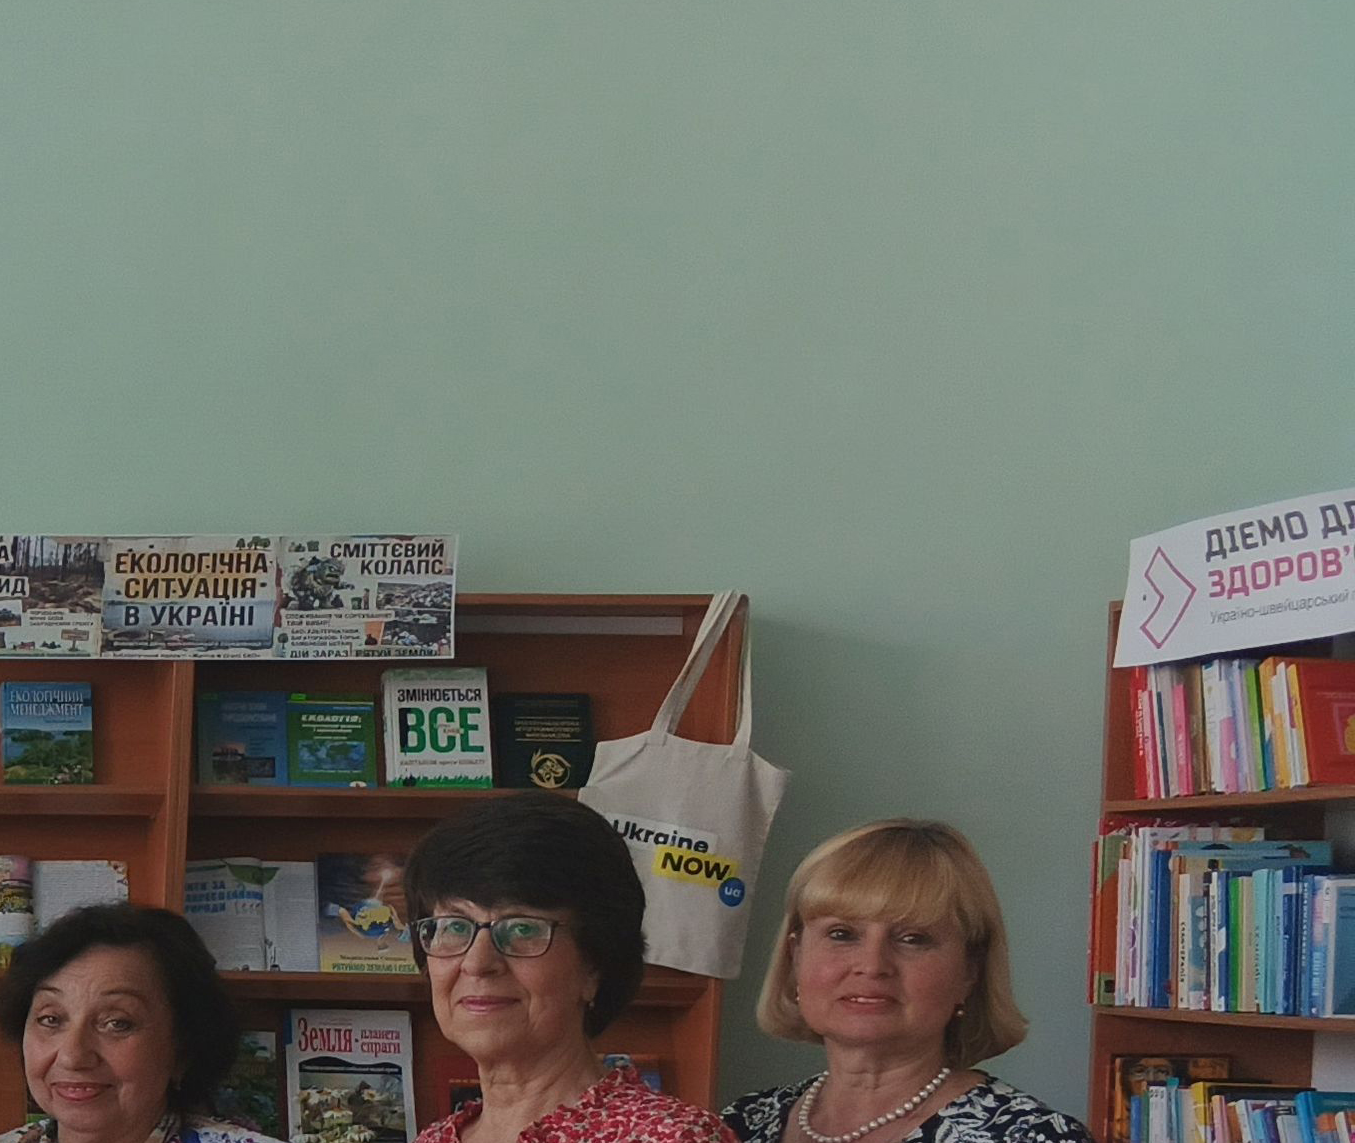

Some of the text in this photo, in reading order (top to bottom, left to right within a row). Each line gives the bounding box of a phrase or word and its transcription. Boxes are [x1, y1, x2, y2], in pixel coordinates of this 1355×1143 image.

[330, 540, 445, 559] СМІТТЄВИЙ
[115, 552, 268, 574] ЕКОЛОГІЧНА
[360, 559, 444, 576] КОЛАПС
[1208, 545, 1355, 599] ЗДОРОВ’
[124, 577, 257, 601] СИТУАЦІЯ
[124, 602, 254, 627] В УКРАЇНІ
[397, 688, 483, 703] ЗМІНЮЄТЬСЯ
[10, 703, 84, 716] МЕНЕДЖМЕНТ
[398, 706, 485, 754] ВСЕ
[611, 819, 710, 853] Ukraine
[660, 852, 731, 881] NOW
[297, 1017, 353, 1053] Земля
[360, 1029, 401, 1040] планета
[360, 1041, 401, 1058] спраги
